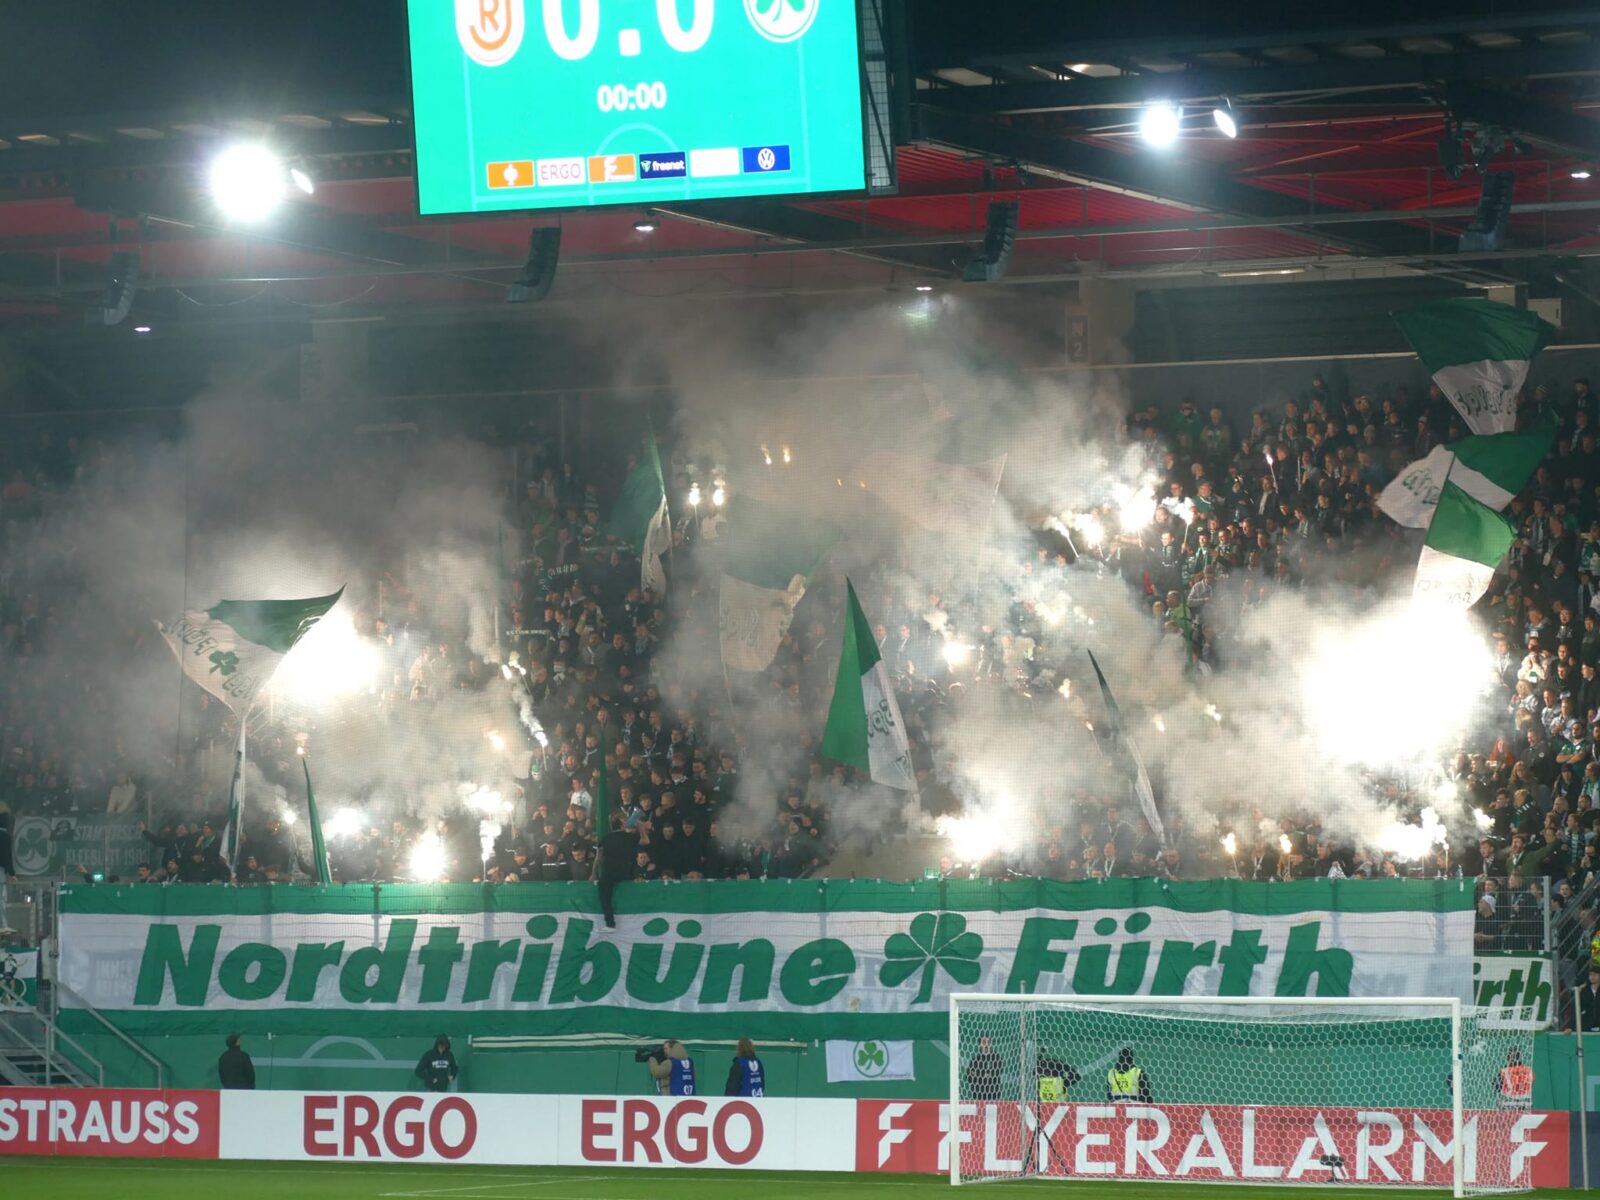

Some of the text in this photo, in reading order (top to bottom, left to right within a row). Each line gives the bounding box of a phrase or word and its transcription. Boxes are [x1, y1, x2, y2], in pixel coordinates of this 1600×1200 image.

[597, 81, 667, 112] 00:00
[541, 163, 581, 180] ERGO
[133, 911, 1354, 1006] Nordtribüne Fürth
[0, 1098, 199, 1145] STRAUSS
[303, 1095, 477, 1159] ERGO
[581, 1098, 764, 1165] ERGO
[938, 1102, 1478, 1184] FLYERALARM
